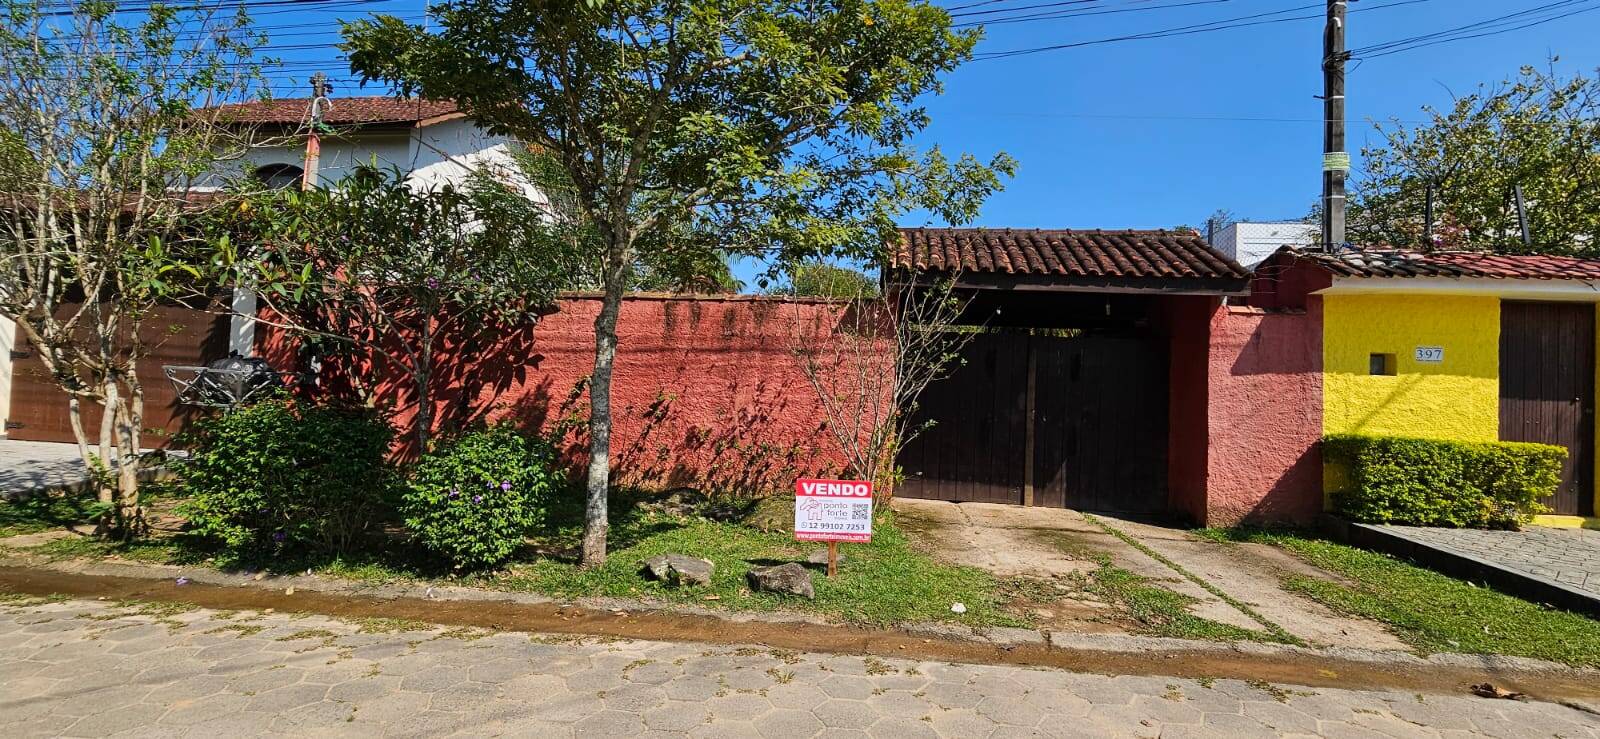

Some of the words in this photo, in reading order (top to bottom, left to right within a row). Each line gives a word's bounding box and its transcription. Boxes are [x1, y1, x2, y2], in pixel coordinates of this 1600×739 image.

[1416, 349, 1442, 359] 397
[802, 483, 868, 496] VENDO
[823, 502, 848, 510] ponto
[827, 509, 848, 517] forte
[820, 522, 844, 530] 99102
[846, 523, 865, 531] 7253
